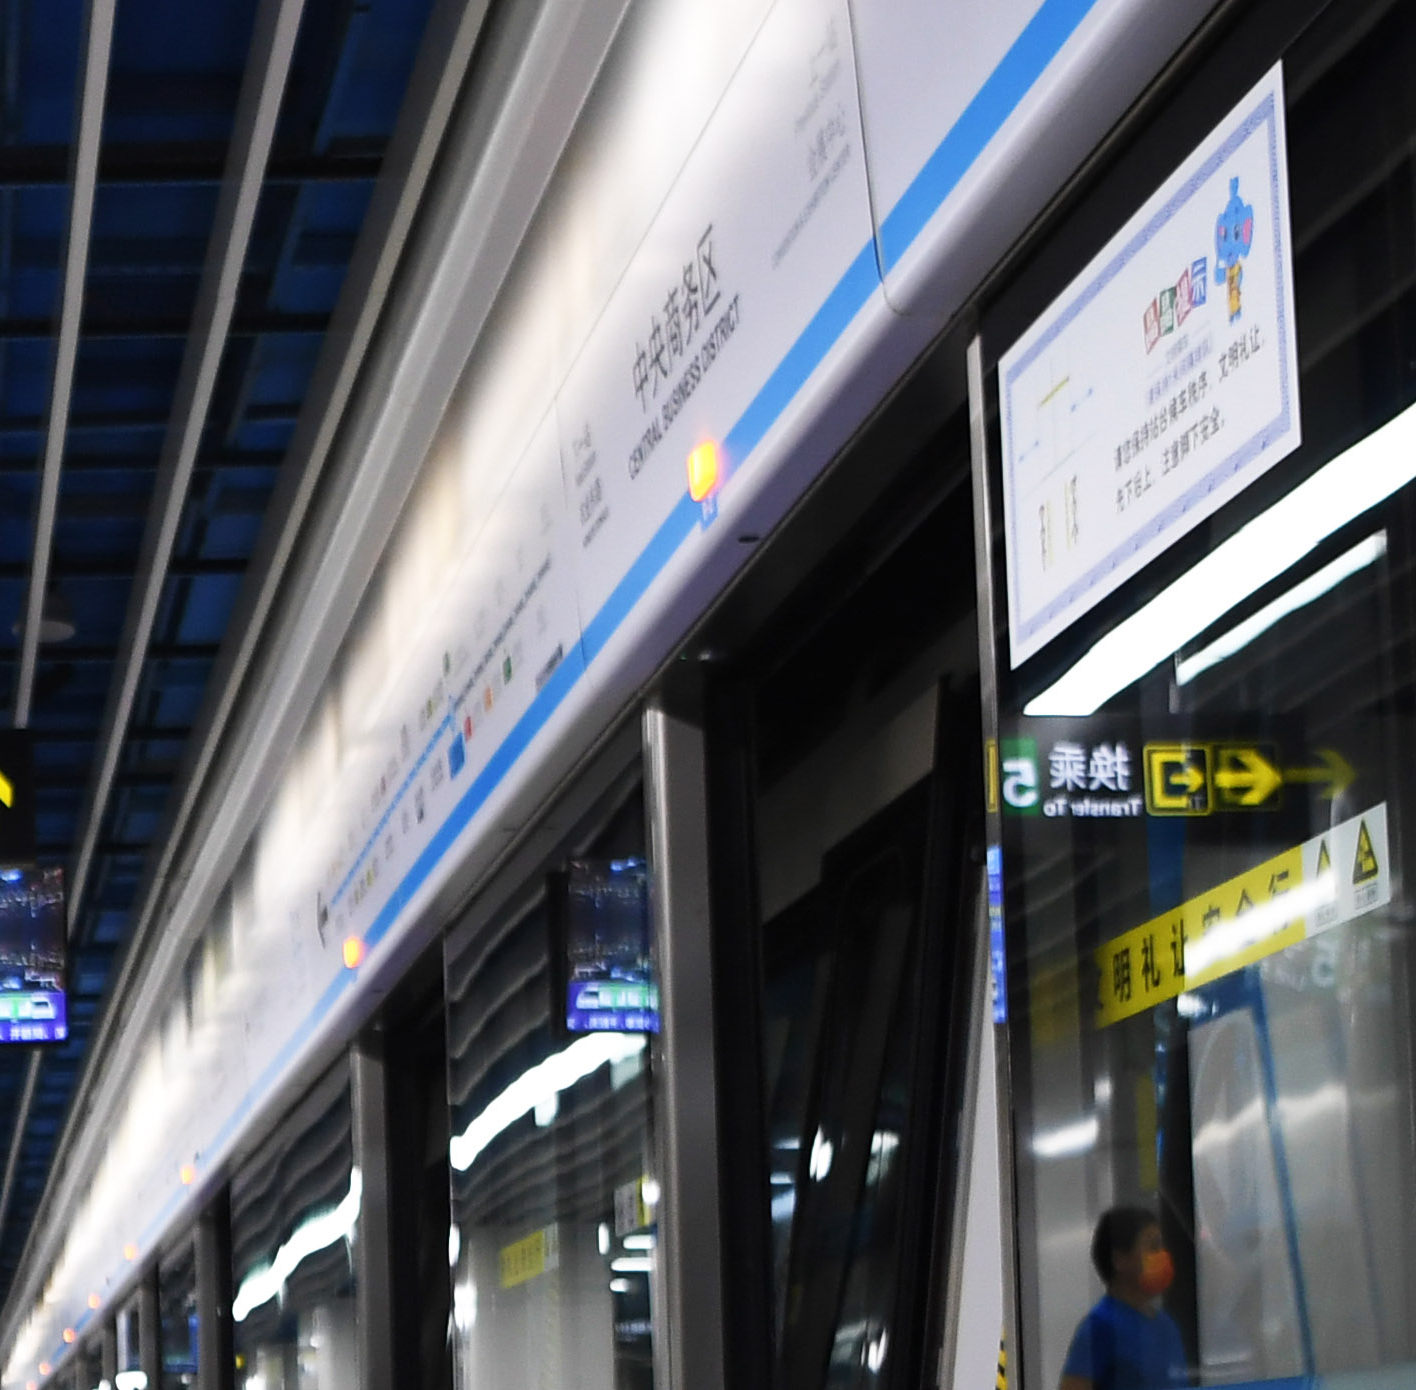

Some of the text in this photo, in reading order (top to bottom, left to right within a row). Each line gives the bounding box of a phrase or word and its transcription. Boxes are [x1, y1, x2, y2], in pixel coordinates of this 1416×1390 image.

[628, 417, 663, 480] CENTRAL
[702, 293, 740, 373] DISTRICT
[632, 223, 720, 413] 中央商务区
